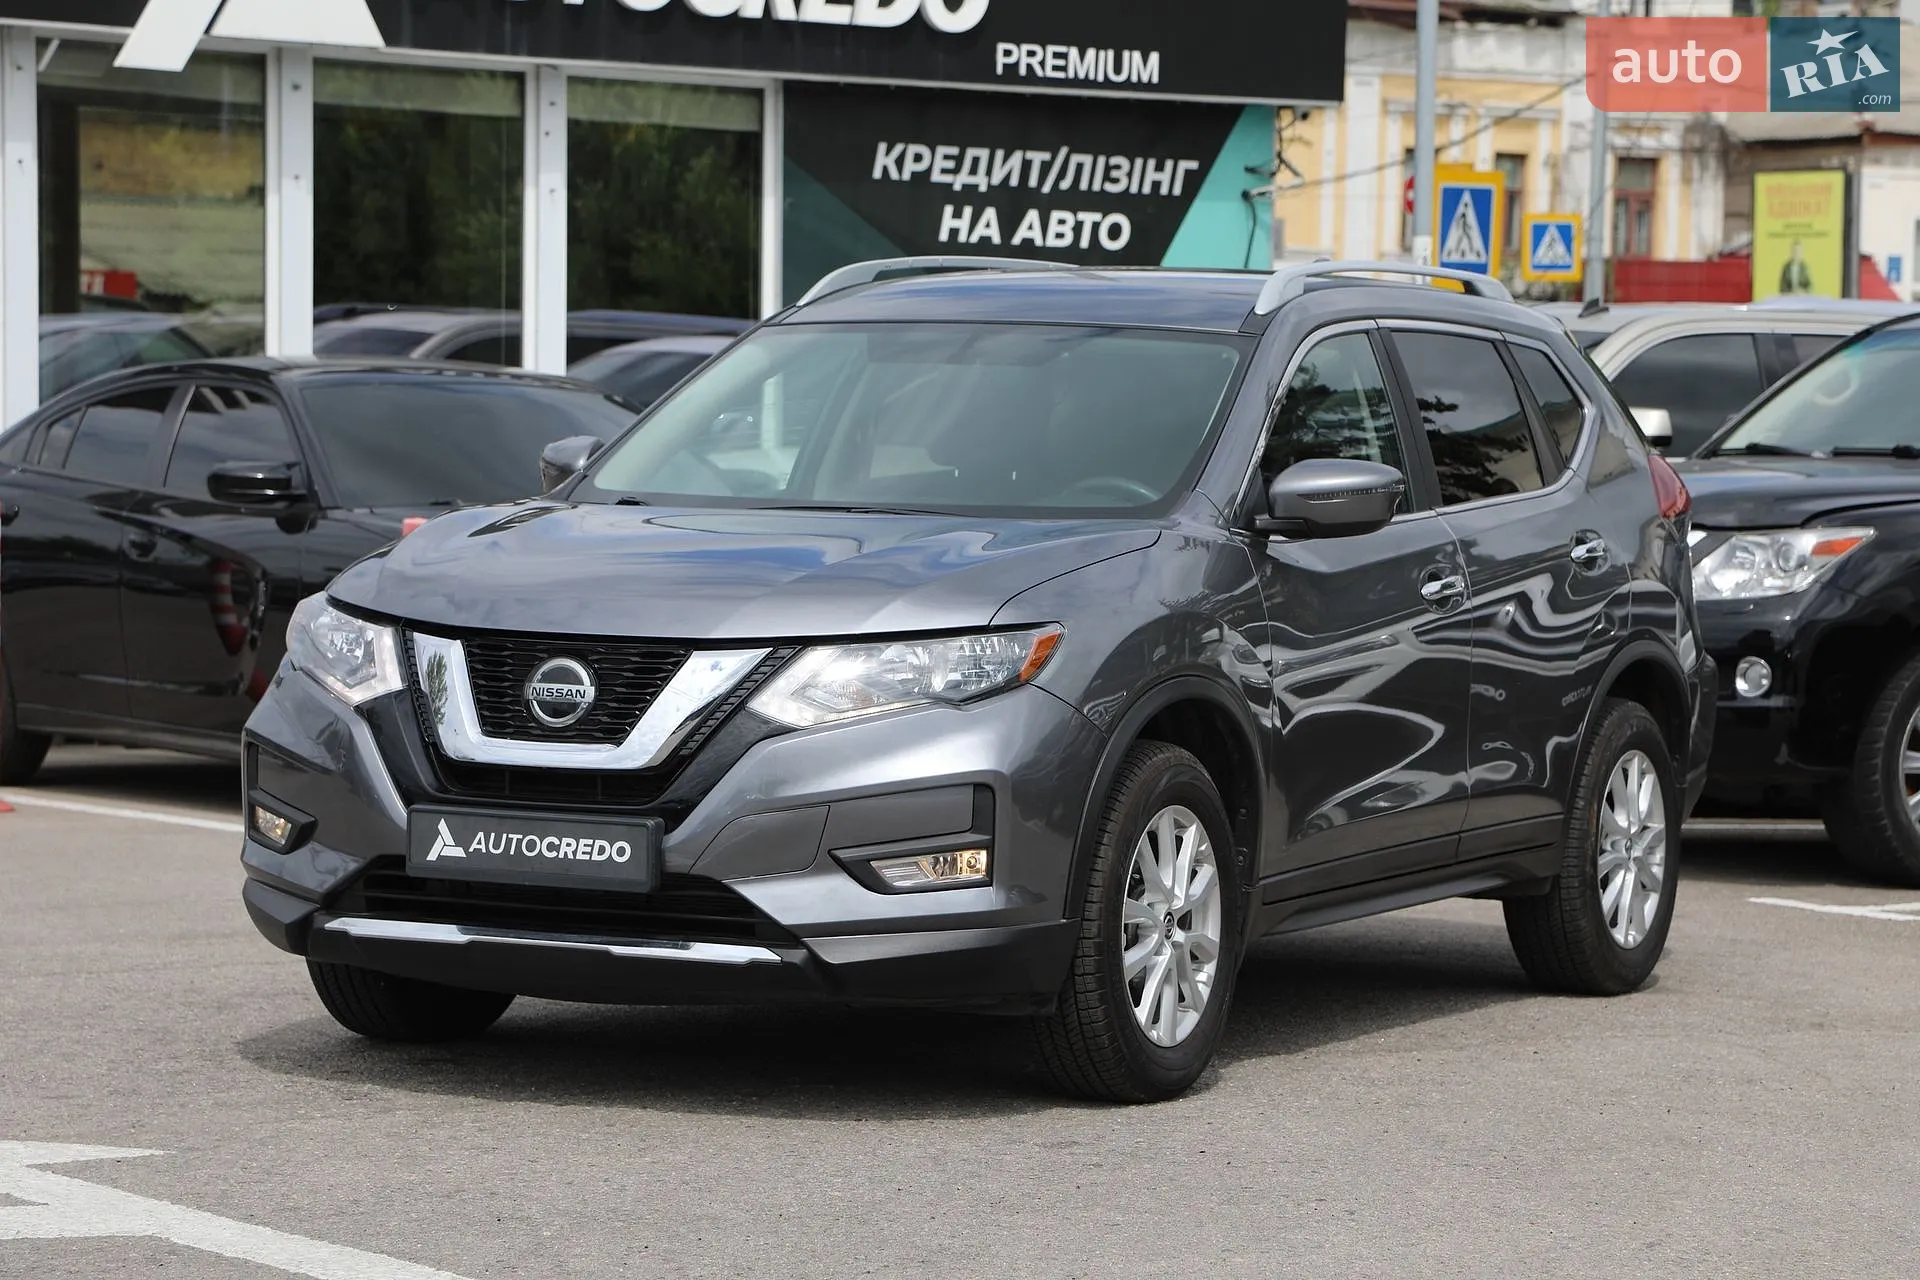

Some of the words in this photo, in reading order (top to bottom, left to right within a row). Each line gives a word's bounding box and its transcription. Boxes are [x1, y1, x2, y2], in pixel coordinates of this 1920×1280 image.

[995, 43, 1160, 85] PREMIUM
[872, 142, 1199, 197] КРЕДИТ/ЛІЗІНГ
[938, 204, 1001, 245] НА
[1010, 208, 1132, 251] АВТО
[531, 686, 586, 699] NISSAN
[468, 831, 632, 863] AUTOCREDO
